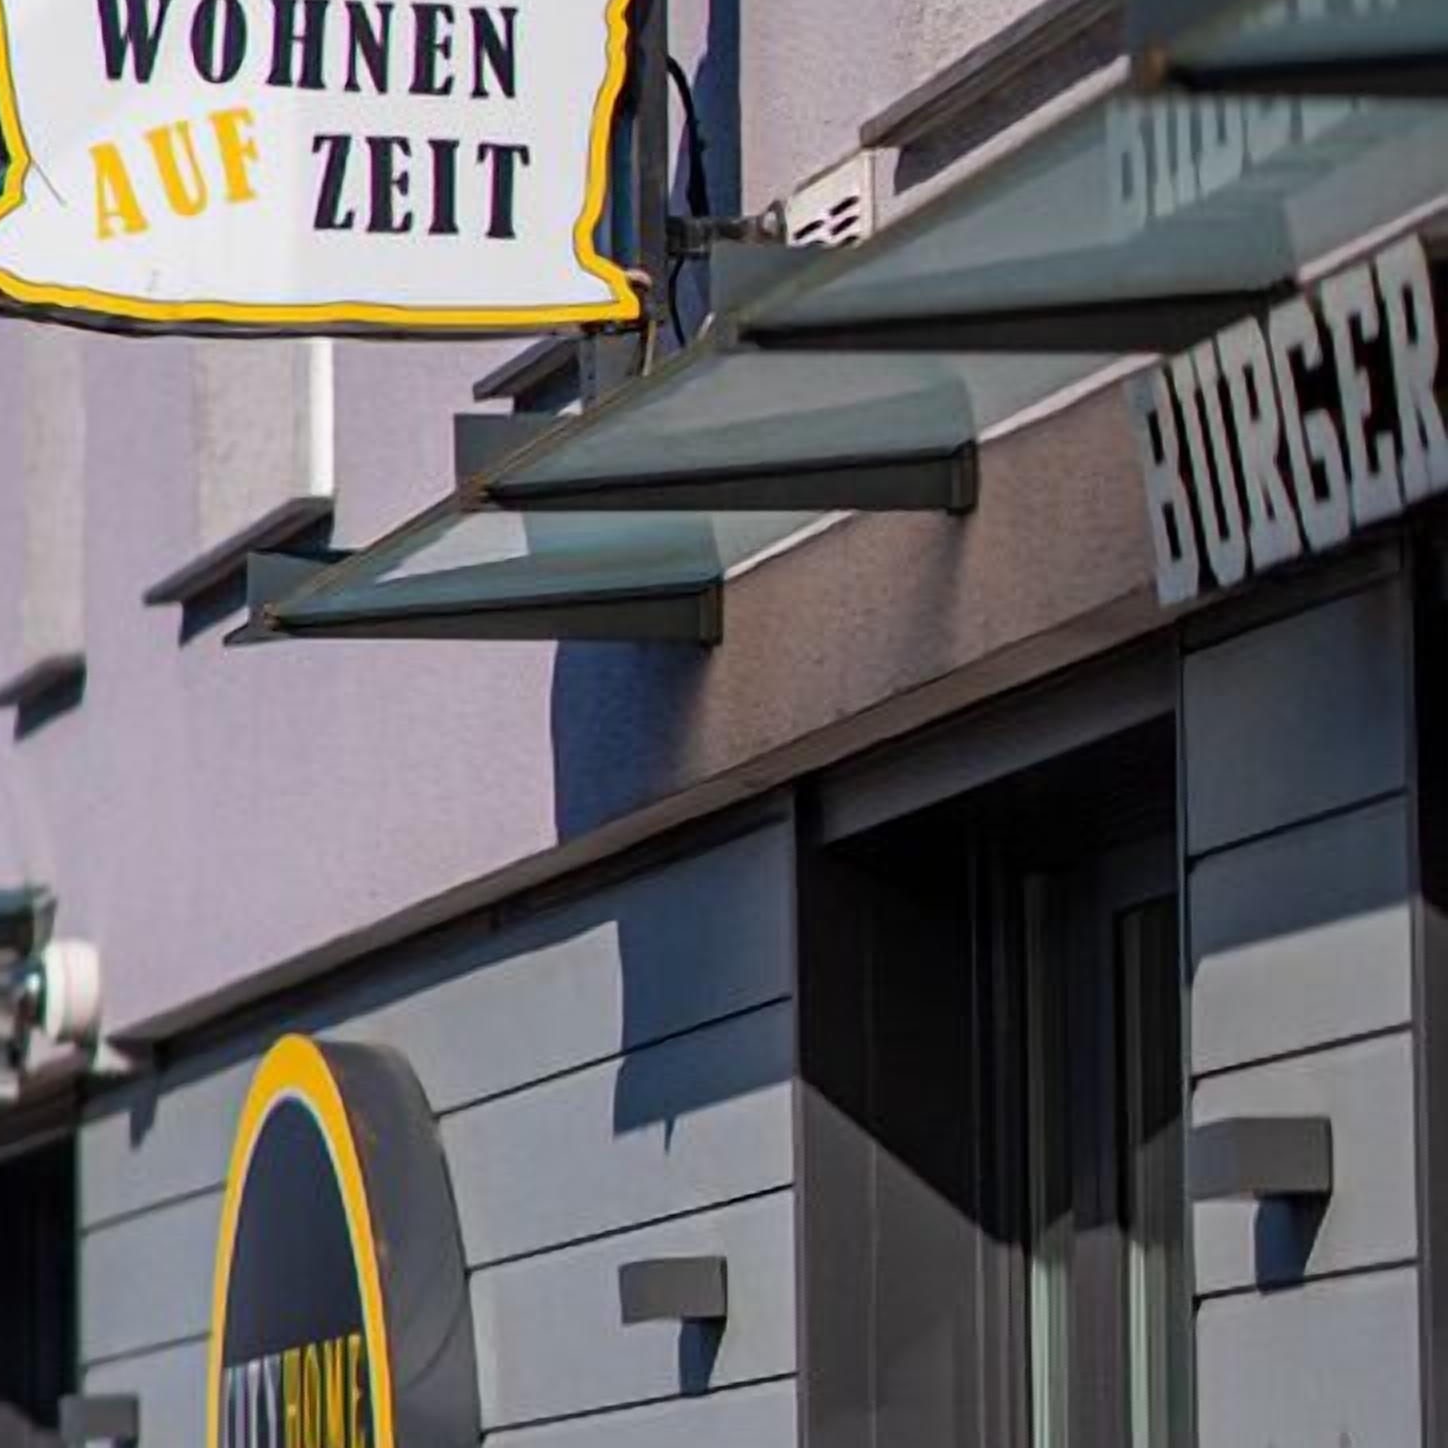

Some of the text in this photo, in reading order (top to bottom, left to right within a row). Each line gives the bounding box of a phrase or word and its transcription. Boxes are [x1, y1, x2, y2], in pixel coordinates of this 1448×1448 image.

[88, 108, 531, 240] AUF ZEIT
[1137, 233, 1448, 607] BURGER
